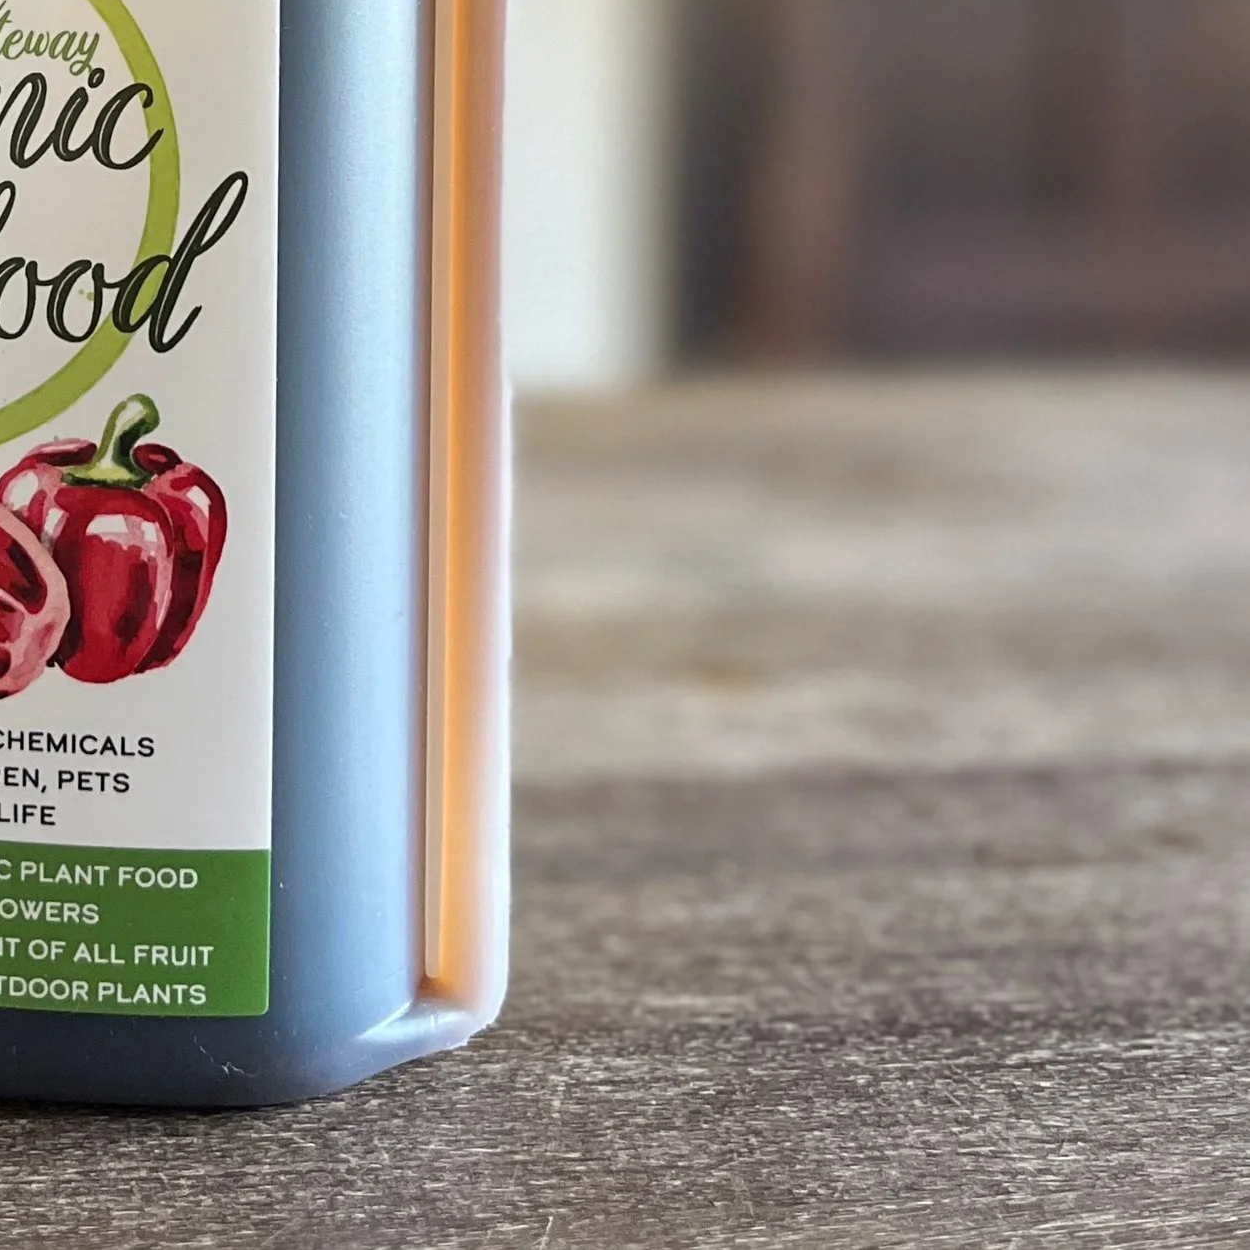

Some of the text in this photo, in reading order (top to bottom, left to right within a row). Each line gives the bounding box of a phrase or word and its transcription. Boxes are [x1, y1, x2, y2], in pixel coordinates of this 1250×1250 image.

[58, 770, 130, 793] PETS
[20, 862, 110, 887] PLANT
[118, 867, 198, 889] FOOD
[28, 939, 66, 961] OF
[73, 942, 125, 964] ALL
[134, 945, 214, 966] FRUIT
[98, 982, 207, 1005] PLANTS
